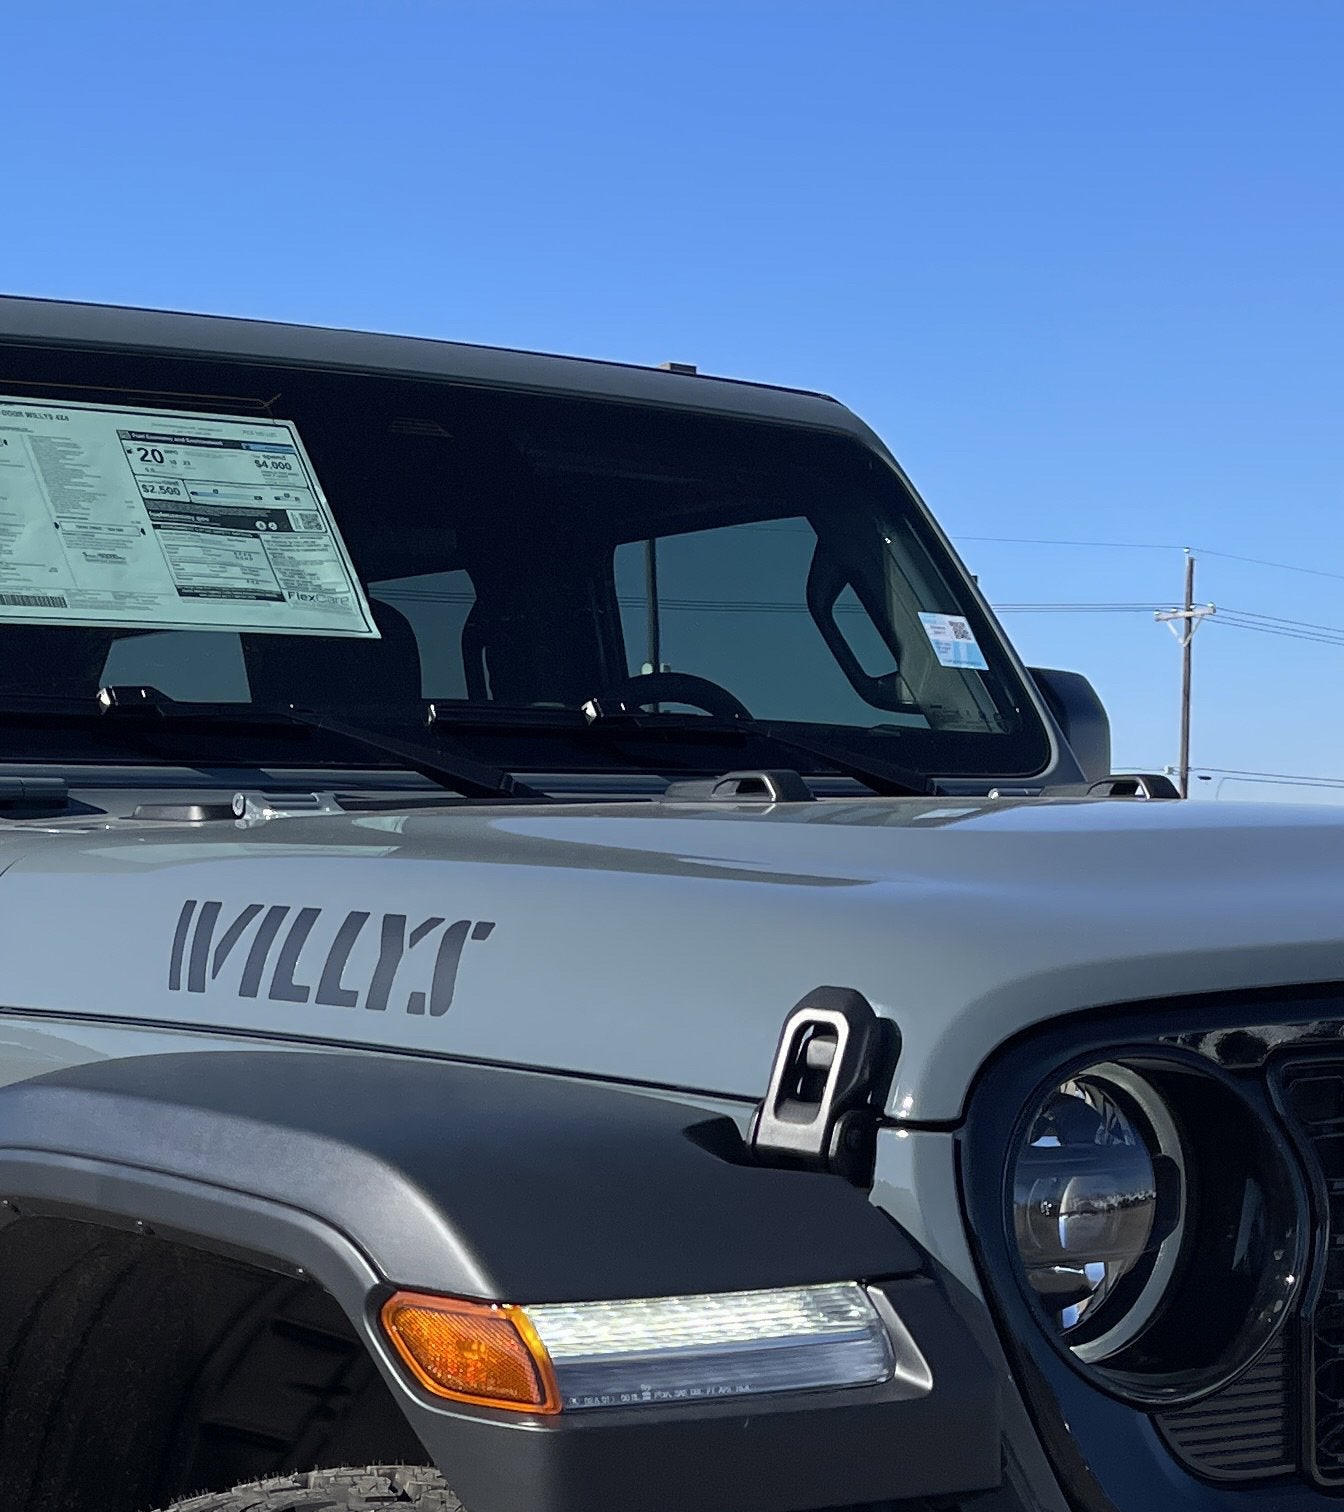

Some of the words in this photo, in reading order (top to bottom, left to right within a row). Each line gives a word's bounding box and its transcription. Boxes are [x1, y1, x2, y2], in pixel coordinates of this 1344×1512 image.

[137, 447, 164, 464] 20
[288, 591, 350, 606] FlexCare
[168, 900, 496, 1017] WILLYS
